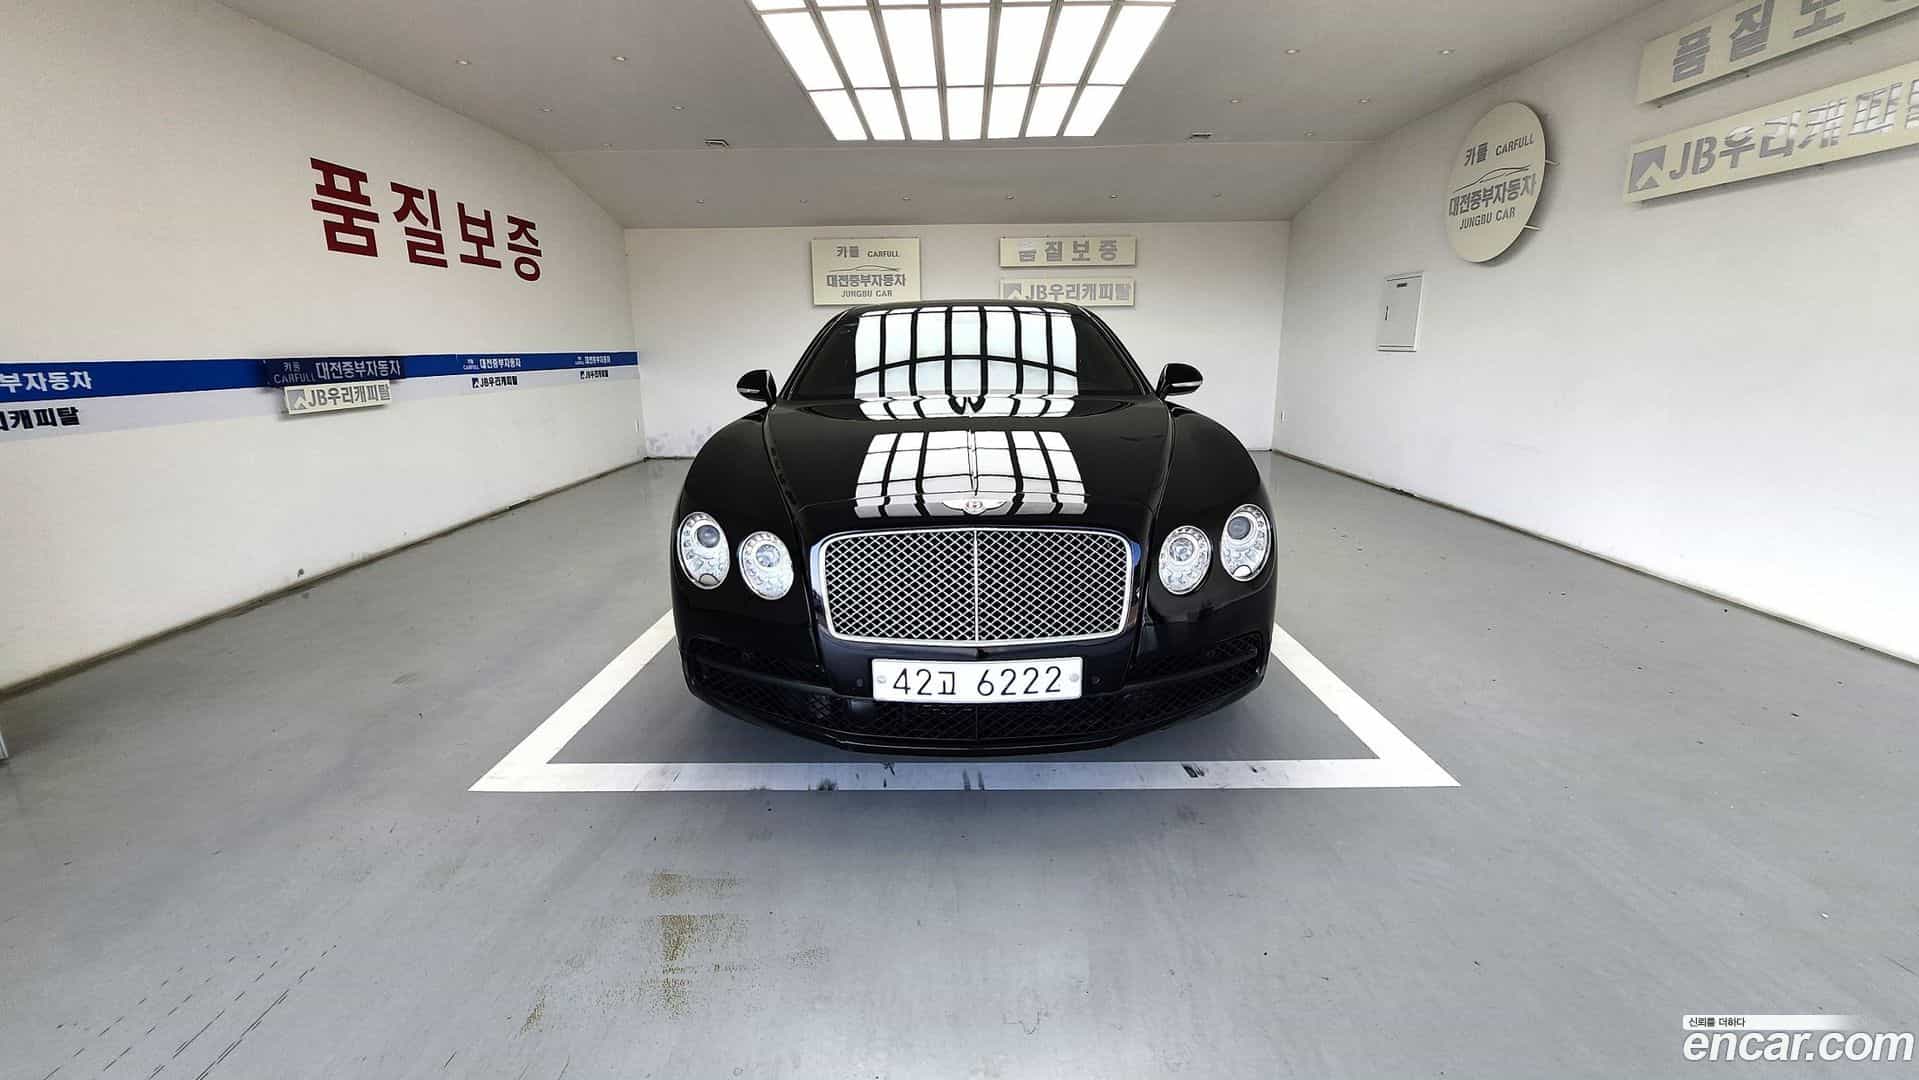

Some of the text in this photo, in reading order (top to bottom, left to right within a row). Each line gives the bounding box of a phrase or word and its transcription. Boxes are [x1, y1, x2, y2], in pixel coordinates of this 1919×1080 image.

[1495, 133, 1534, 156] CARFULL
[1448, 173, 1536, 216] 대전중부자동차
[310, 157, 542, 282] 품질보증
[1495, 206, 1515, 221] CAR
[867, 250, 899, 258] CARFULL
[826, 274, 906, 287] 대전중부자동차
[315, 360, 401, 380] 대전중부자동차
[308, 383, 391, 407] JB우리캐피탈
[893, 666, 1061, 696] 42고 6222
